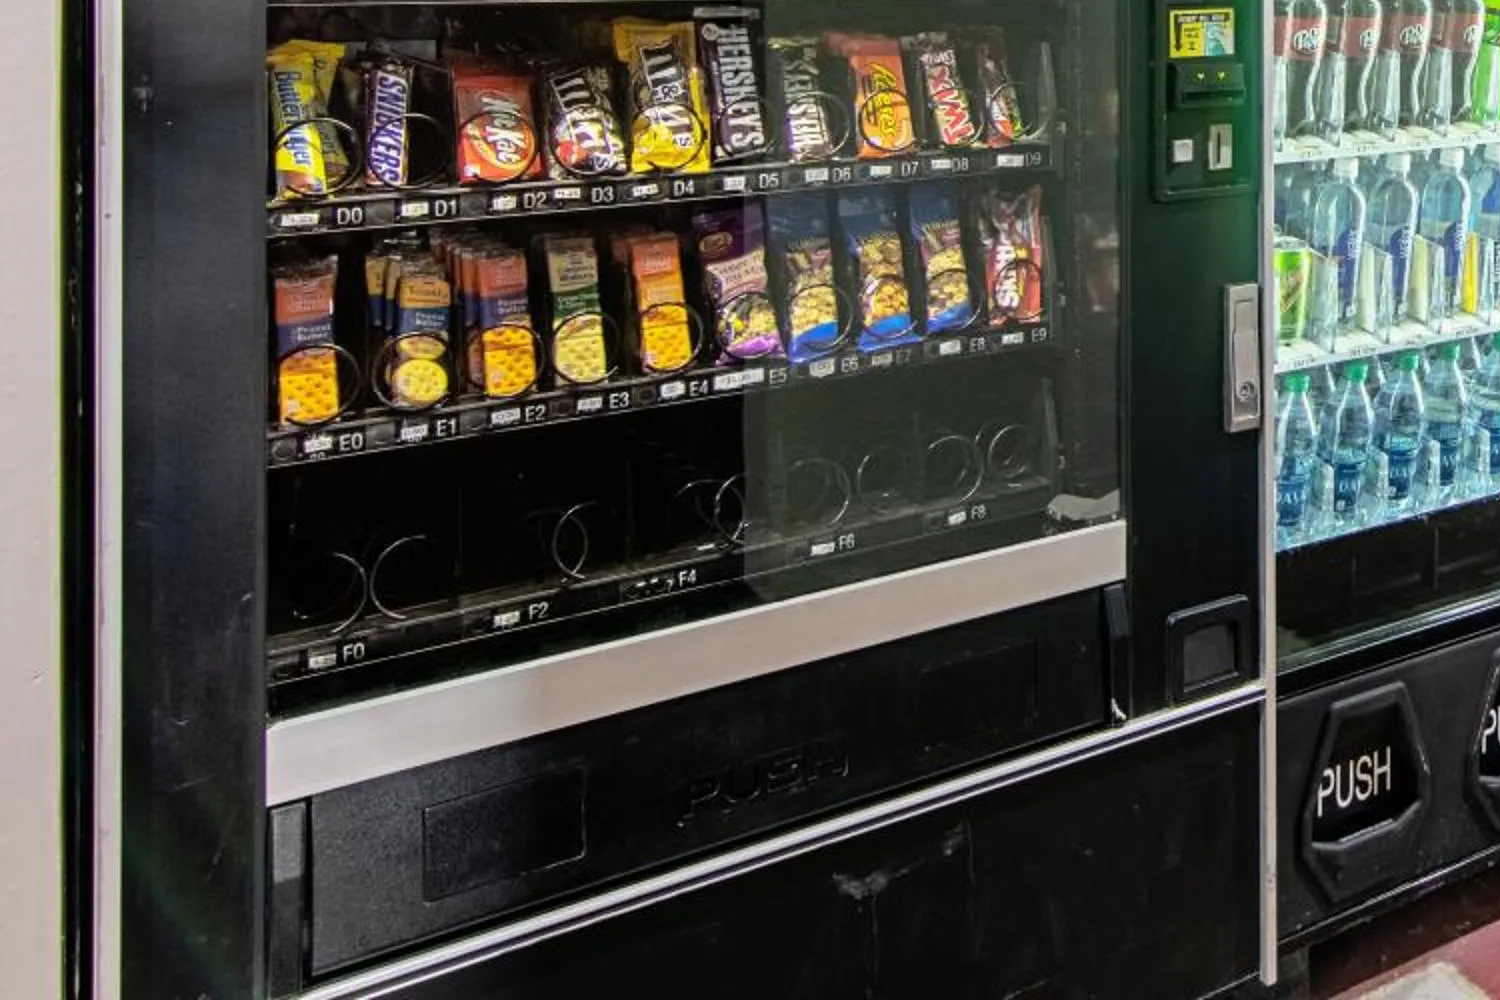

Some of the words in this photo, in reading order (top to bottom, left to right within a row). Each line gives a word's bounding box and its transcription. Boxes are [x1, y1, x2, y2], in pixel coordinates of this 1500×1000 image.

[371, 75, 409, 185] SNICKERS
[951, 157, 969, 172] D8
[1025, 153, 1042, 167] D9
[833, 169, 852, 183] D6
[901, 162, 919, 176] D7
[673, 180, 695, 196] D4
[759, 173, 779, 189] D5
[523, 191, 547, 209] D2
[591, 186, 614, 203] D3
[337, 207, 363, 225] D0
[435, 200, 458, 217] D1
[1031, 328, 1047, 342] E9
[841, 358, 859, 373] E6
[770, 369, 787, 384] E5
[689, 381, 708, 397] E4
[609, 392, 630, 409] E3
[525, 405, 546, 422] E2
[437, 419, 457, 437] E1
[339, 433, 363, 450] E0
[971, 505, 987, 520] F8
[679, 569, 697, 586] F4
[528, 602, 549, 620] F2
[342, 643, 366, 662] F0
[1317, 745, 1392, 818] PUSH
